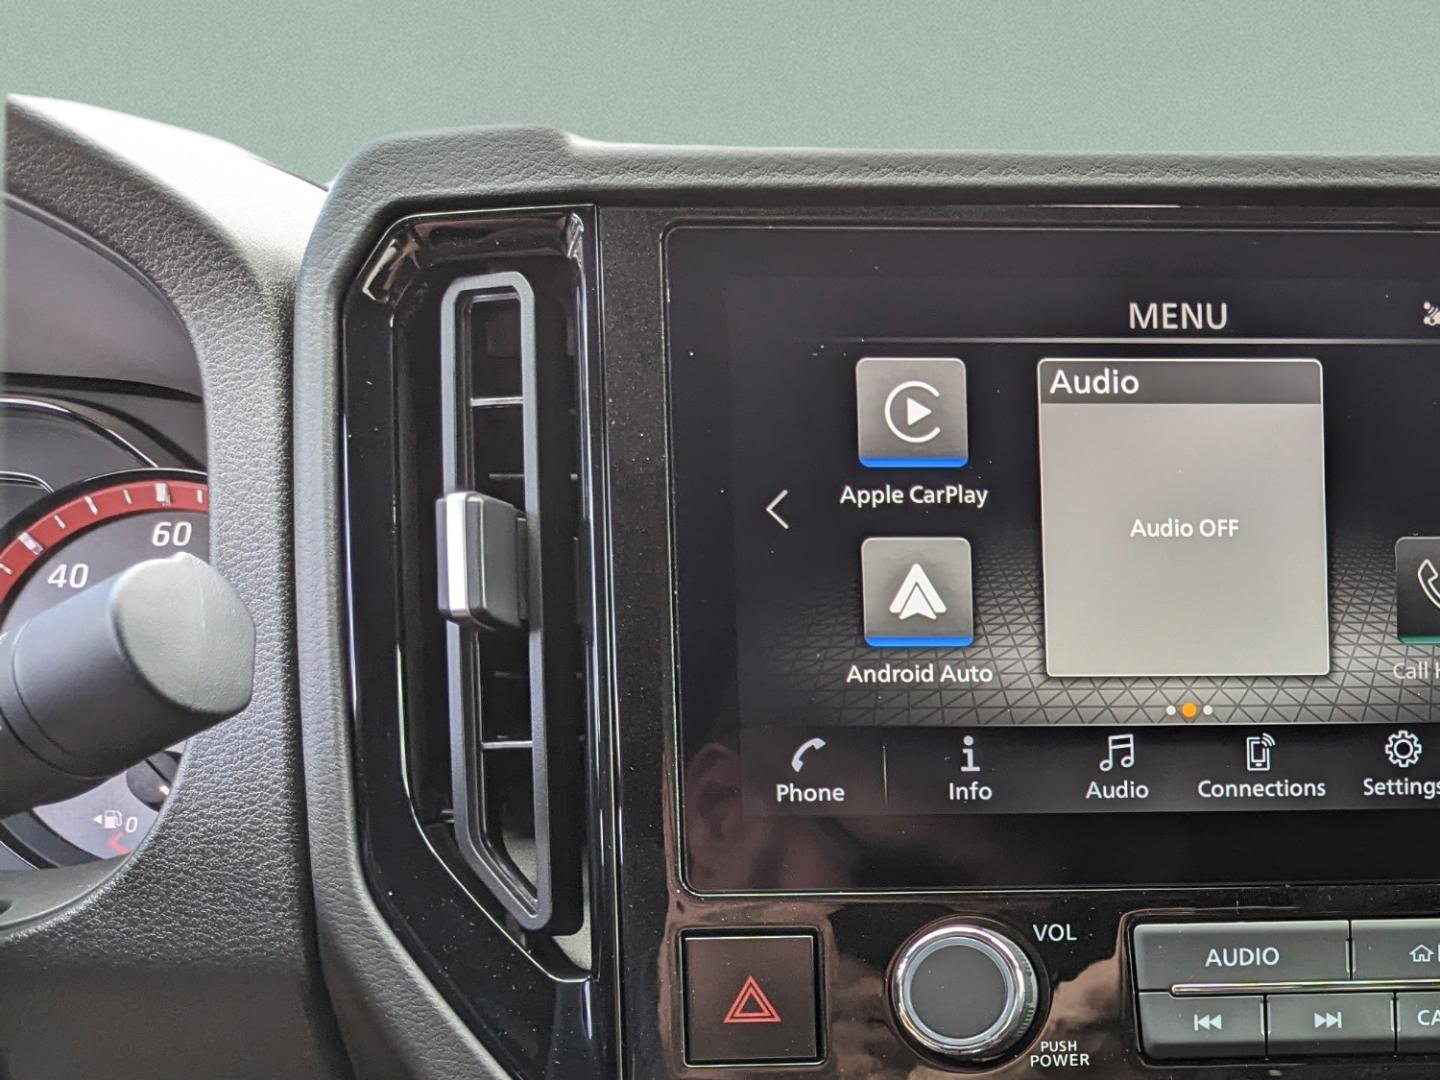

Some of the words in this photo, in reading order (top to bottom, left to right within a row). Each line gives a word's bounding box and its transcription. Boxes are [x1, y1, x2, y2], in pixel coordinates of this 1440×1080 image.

[1128, 302, 1228, 331] MENU
[1050, 369, 1140, 395] Audio
[840, 485, 904, 507] Apple
[909, 484, 988, 508] CarPlay
[151, 521, 192, 546] 60
[1130, 518, 1194, 538] Audio
[1199, 518, 1240, 538] OFF
[48, 562, 88, 589] 40
[846, 663, 934, 684] Android
[940, 662, 993, 683] Auto
[1392, 661, 1429, 680] Call
[776, 782, 845, 802] Phone
[948, 781, 993, 801] Info
[1086, 779, 1149, 800] Audio
[1198, 778, 1326, 799] Connections
[1033, 923, 1077, 942] VOL
[1205, 946, 1280, 968] AUDIO
[1040, 1041, 1078, 1053] PUSH
[1030, 1053, 1090, 1067] POWER
